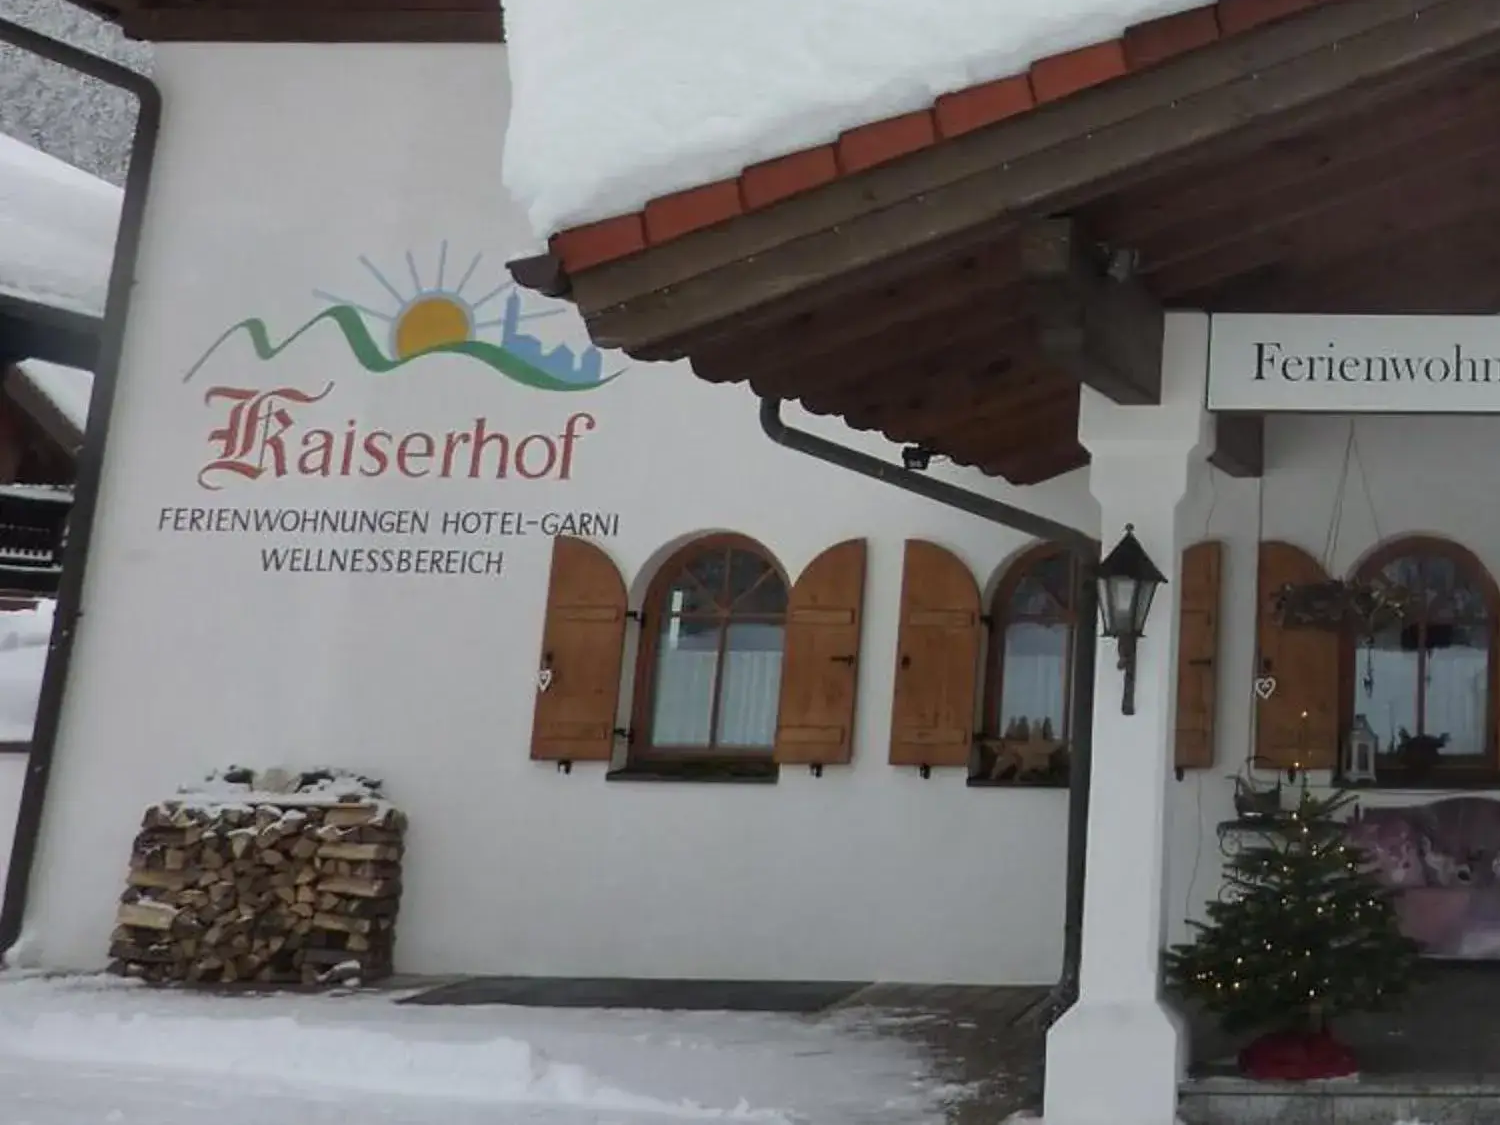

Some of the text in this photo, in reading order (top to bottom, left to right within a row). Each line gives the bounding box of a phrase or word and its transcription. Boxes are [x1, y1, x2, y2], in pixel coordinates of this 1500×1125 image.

[197, 380, 597, 491] Kaiserhof
[157, 506, 621, 538] FERIENWOHNUNGEN HOTEL-GARNI
[260, 548, 504, 575] WELLNESSBEREICH
